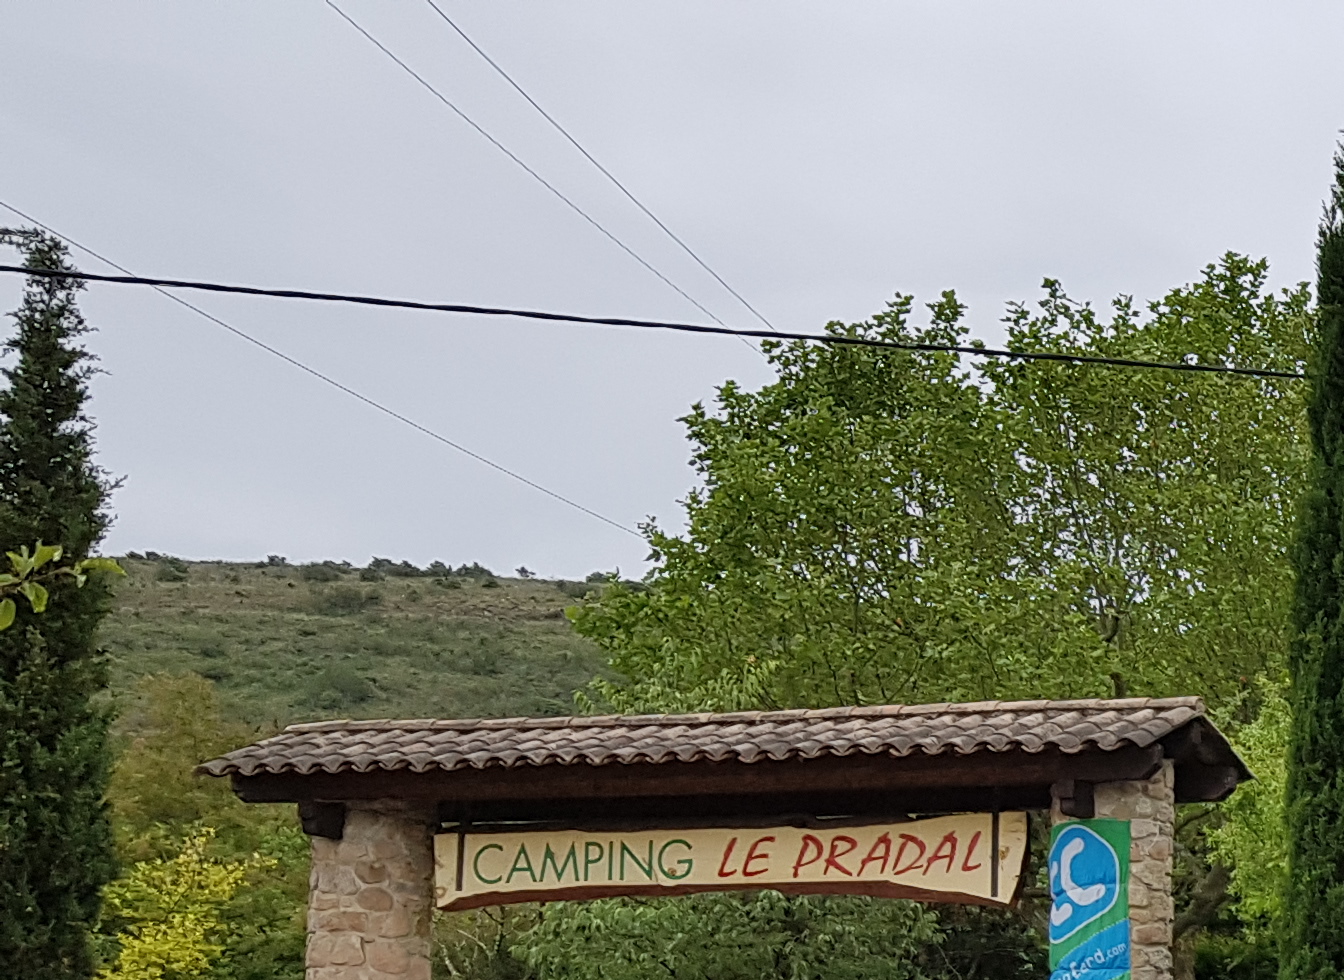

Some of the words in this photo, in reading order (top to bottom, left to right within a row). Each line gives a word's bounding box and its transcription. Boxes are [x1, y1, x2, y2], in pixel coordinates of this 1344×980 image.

[472, 838, 694, 886] CAMPING
[717, 836, 776, 879] LE
[792, 829, 983, 879] PRADAL
